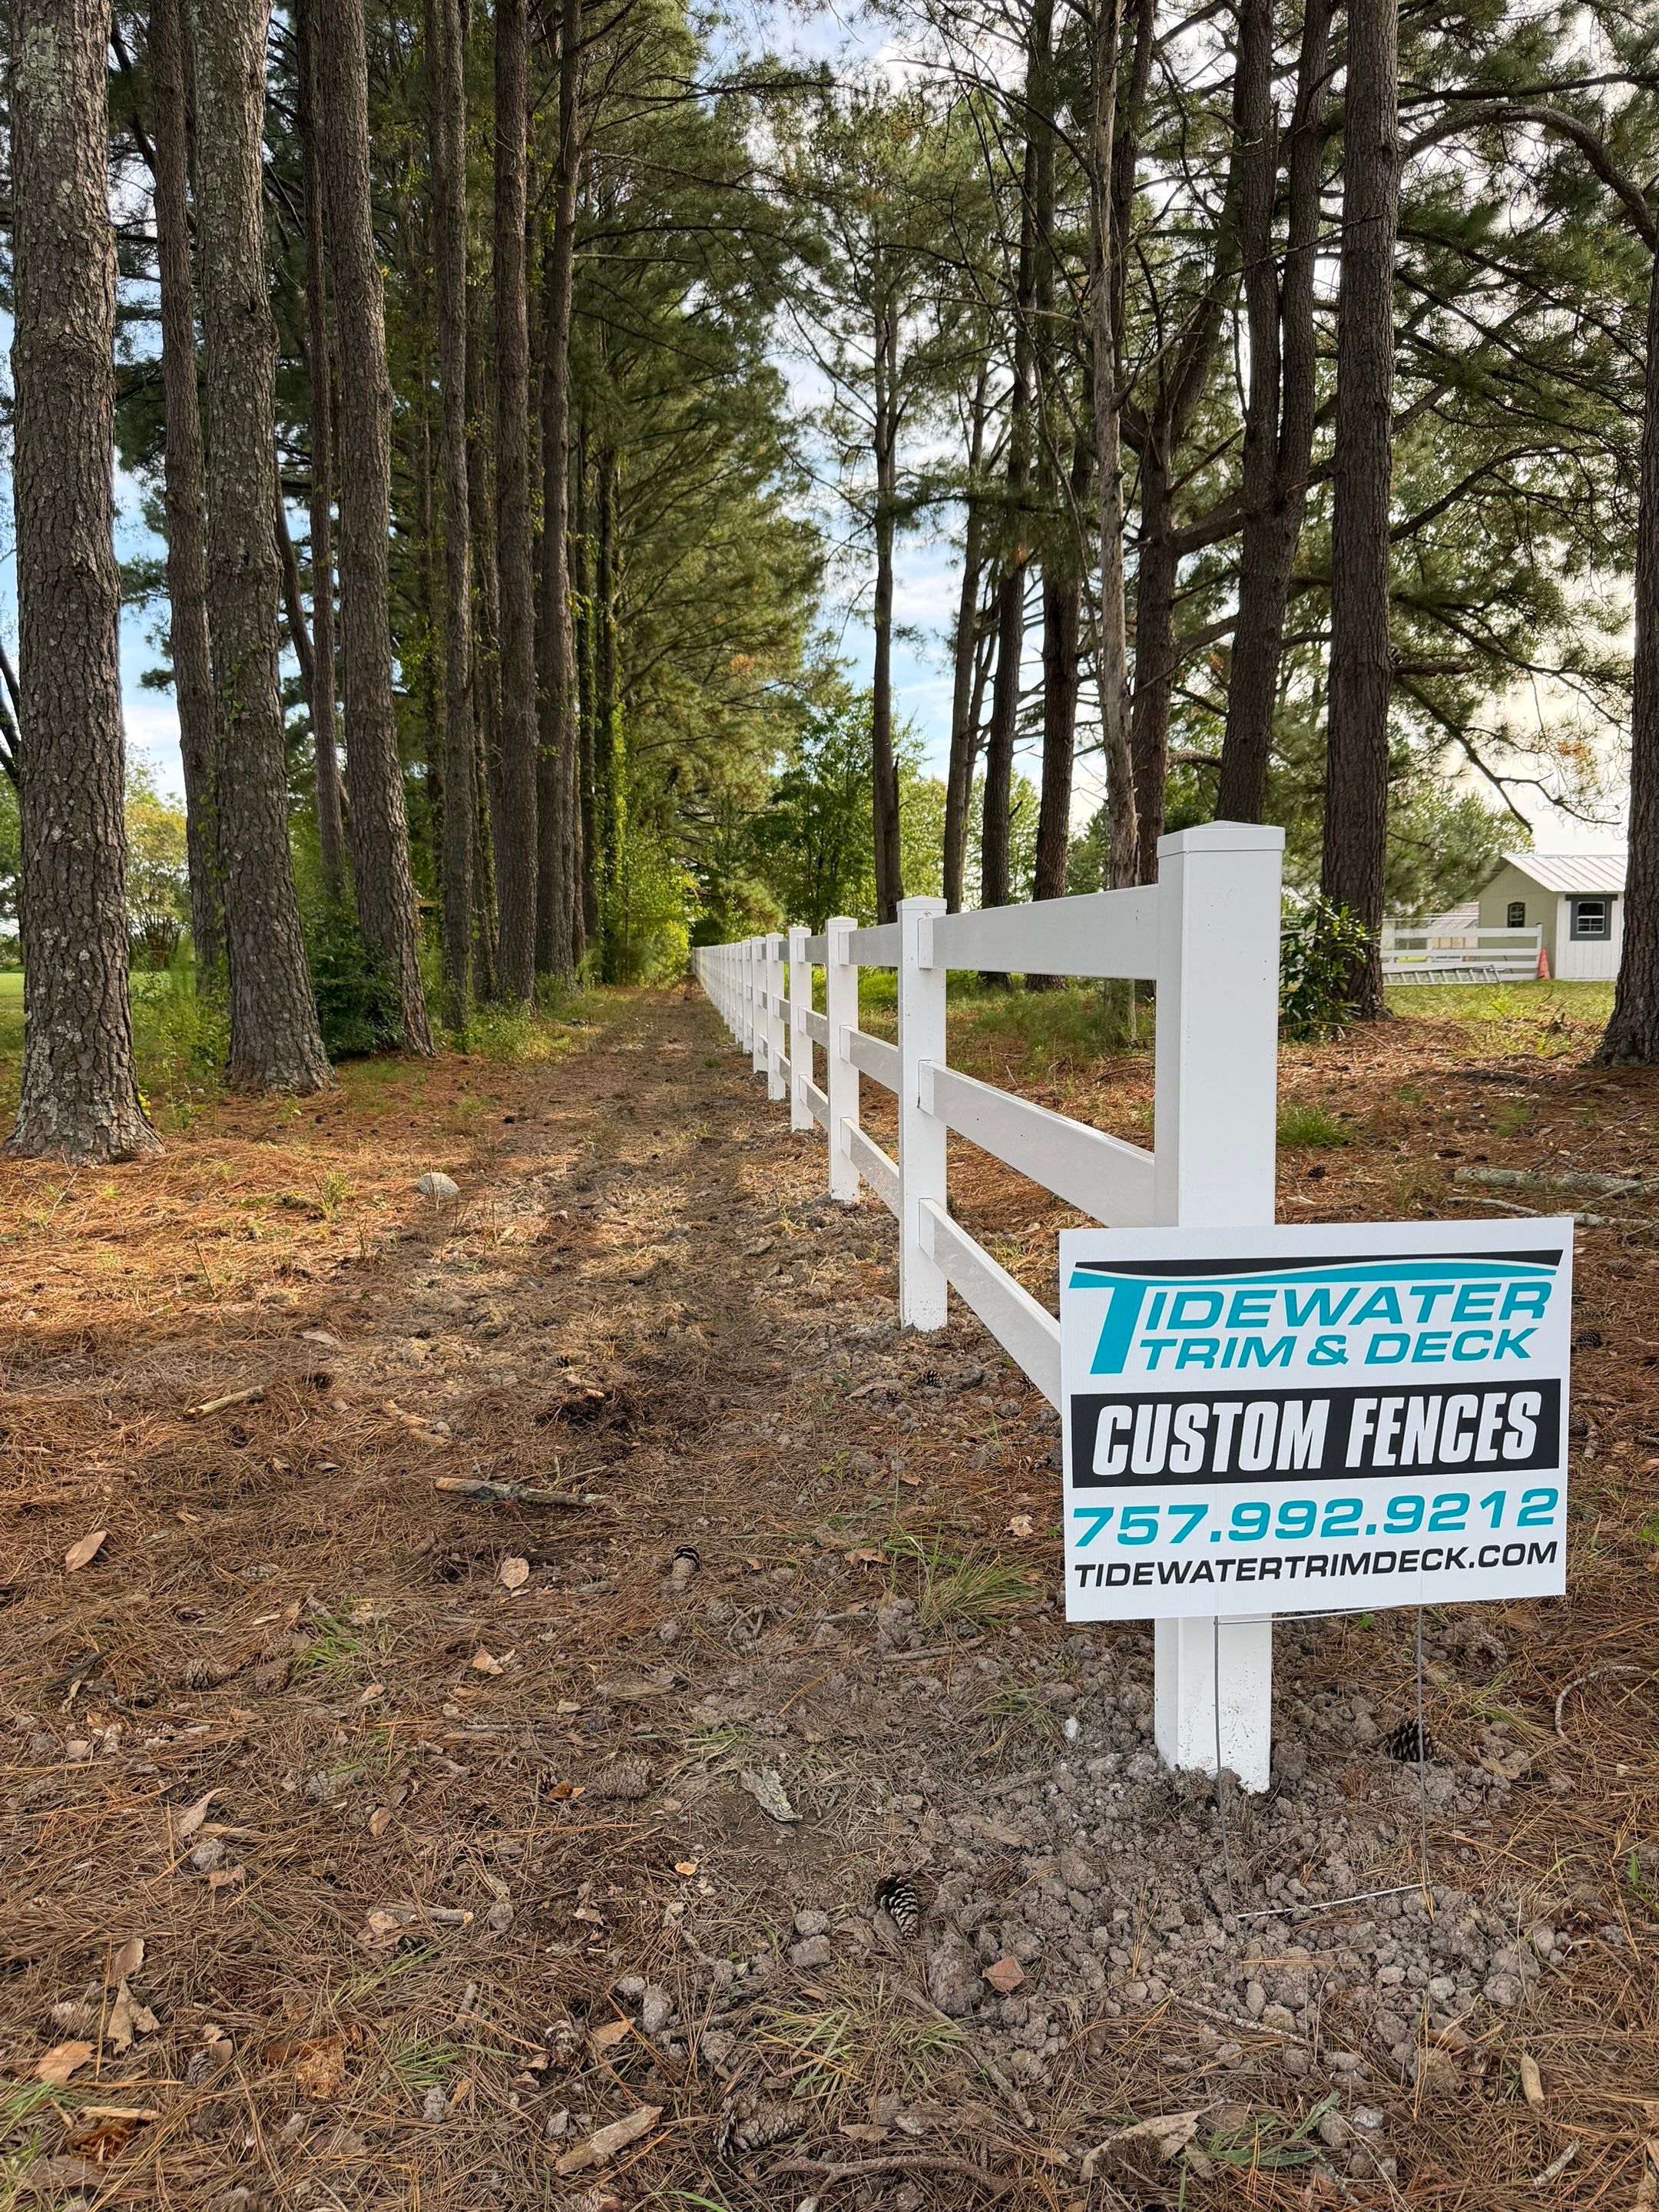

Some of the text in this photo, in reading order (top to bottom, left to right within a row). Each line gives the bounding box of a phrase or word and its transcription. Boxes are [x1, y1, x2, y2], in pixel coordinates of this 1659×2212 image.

[1068, 1262, 1558, 1374] TIDEWATER
[1139, 1327, 1539, 1371] TRIM & DECK
[1091, 1391, 1542, 1476] CUSTOM FENCES
[1072, 1488, 1559, 1548] 757.992.9212
[1075, 1541, 1558, 1588] TIDEWATERTRIMDECK.COM
